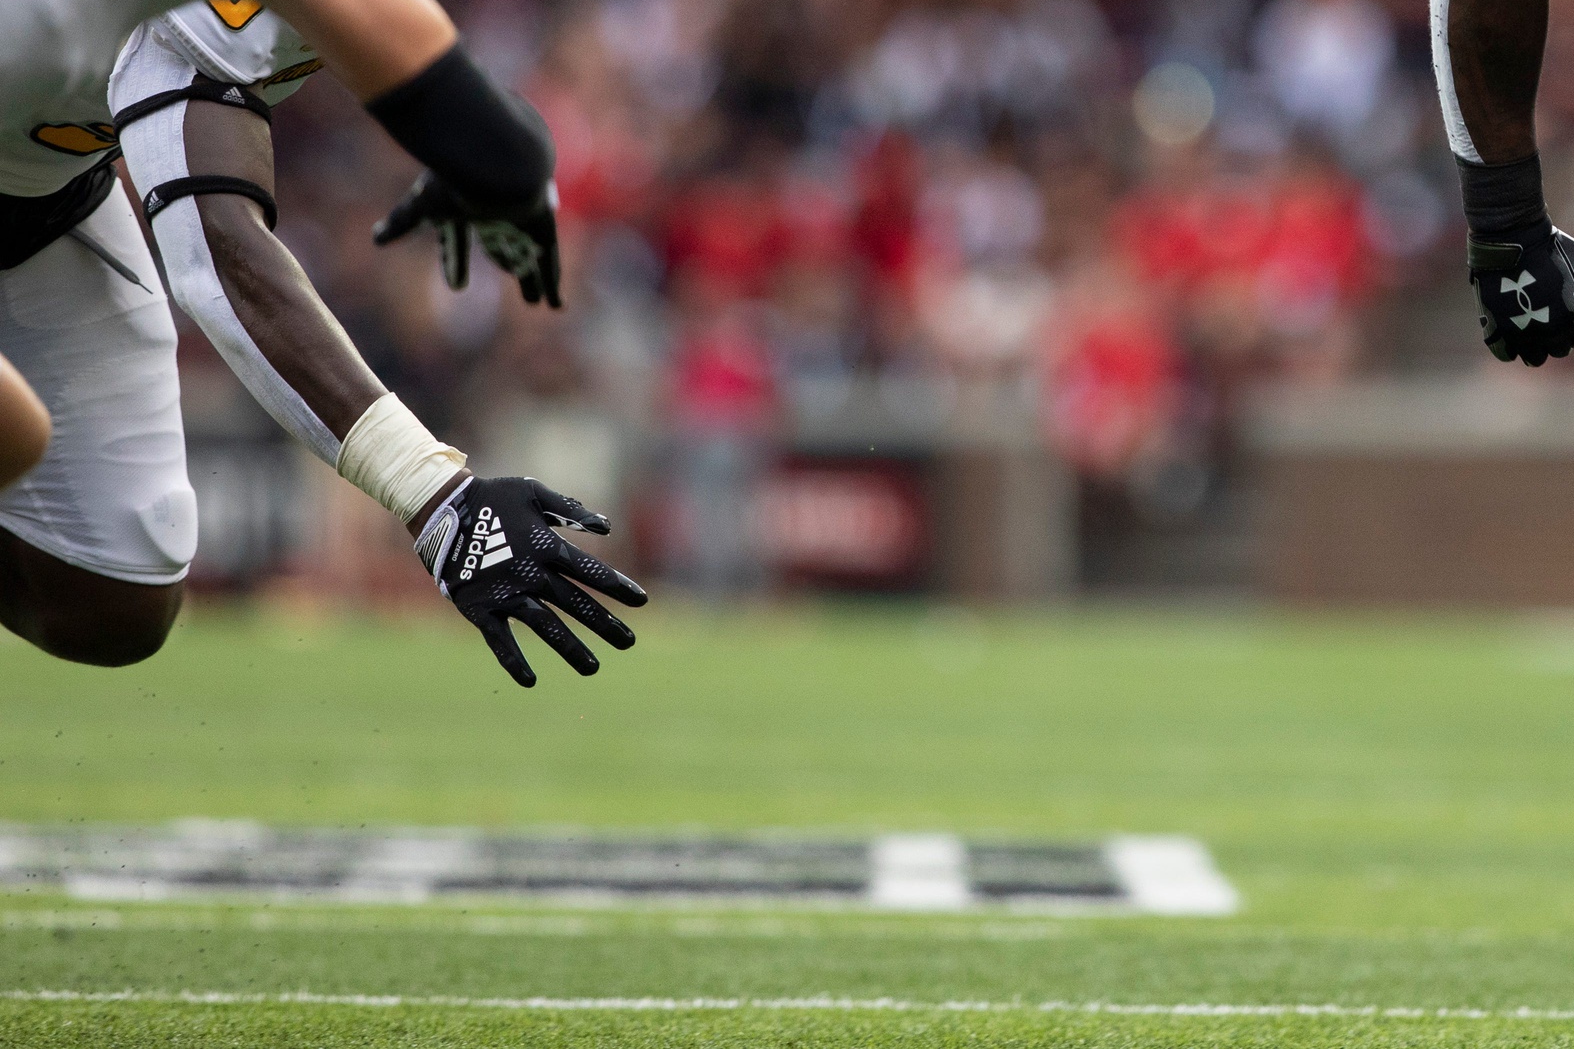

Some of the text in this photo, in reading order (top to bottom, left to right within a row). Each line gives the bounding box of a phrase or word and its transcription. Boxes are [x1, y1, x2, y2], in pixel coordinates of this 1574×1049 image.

[222, 94, 246, 105] adidas
[451, 532, 465, 562] ADIZERO
[460, 507, 493, 580] adidas
